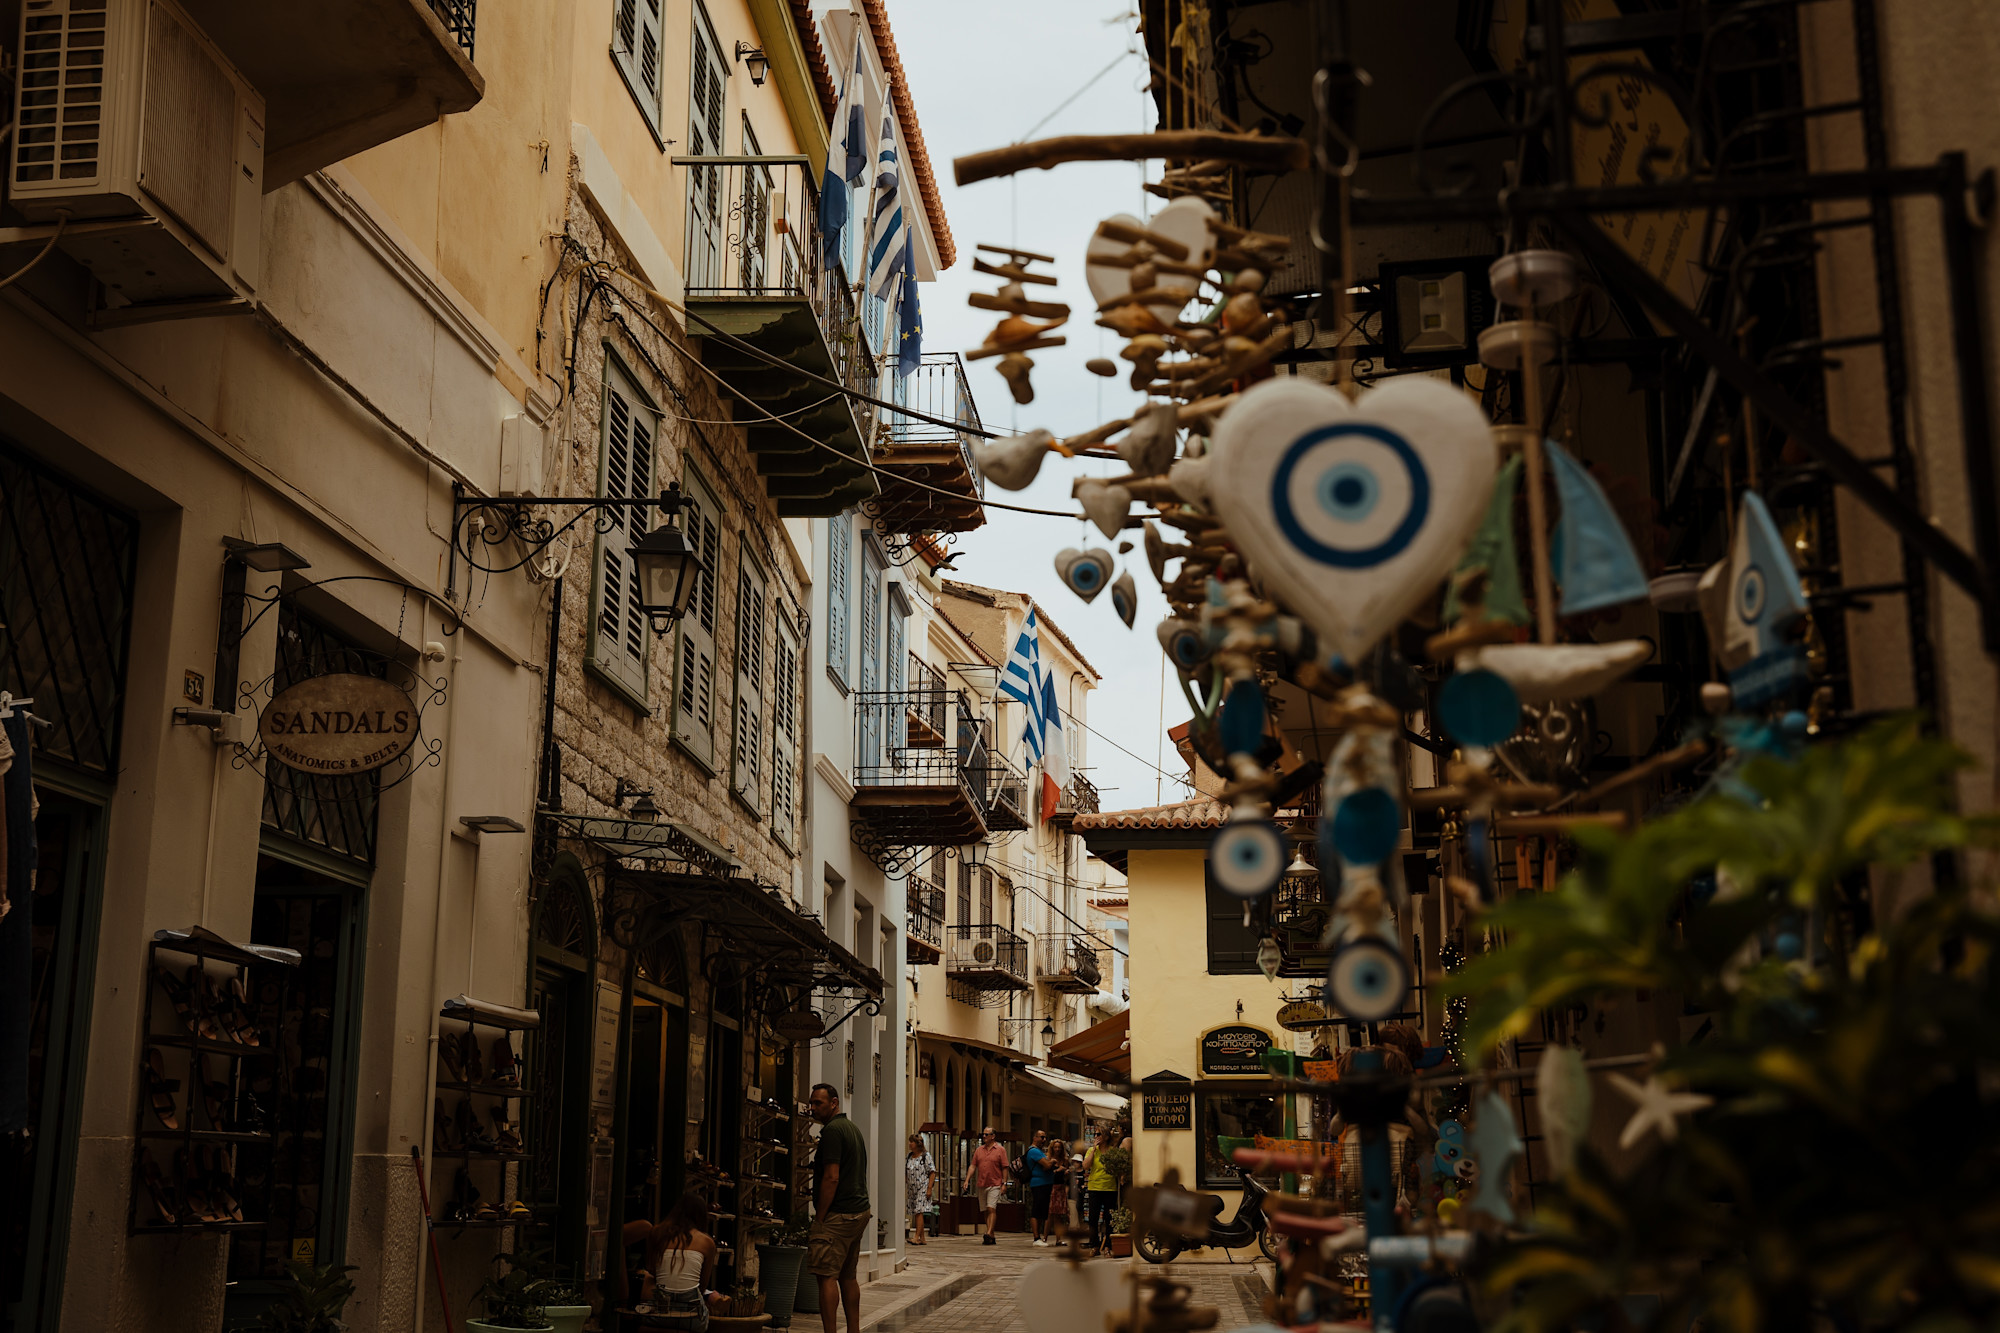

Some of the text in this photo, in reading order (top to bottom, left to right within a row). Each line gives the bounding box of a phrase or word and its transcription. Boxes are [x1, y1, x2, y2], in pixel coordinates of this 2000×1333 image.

[187, 678, 202, 698] 54
[270, 711, 409, 735] SANDALS
[274, 741, 400, 770] ANATOMICS & BELTS
